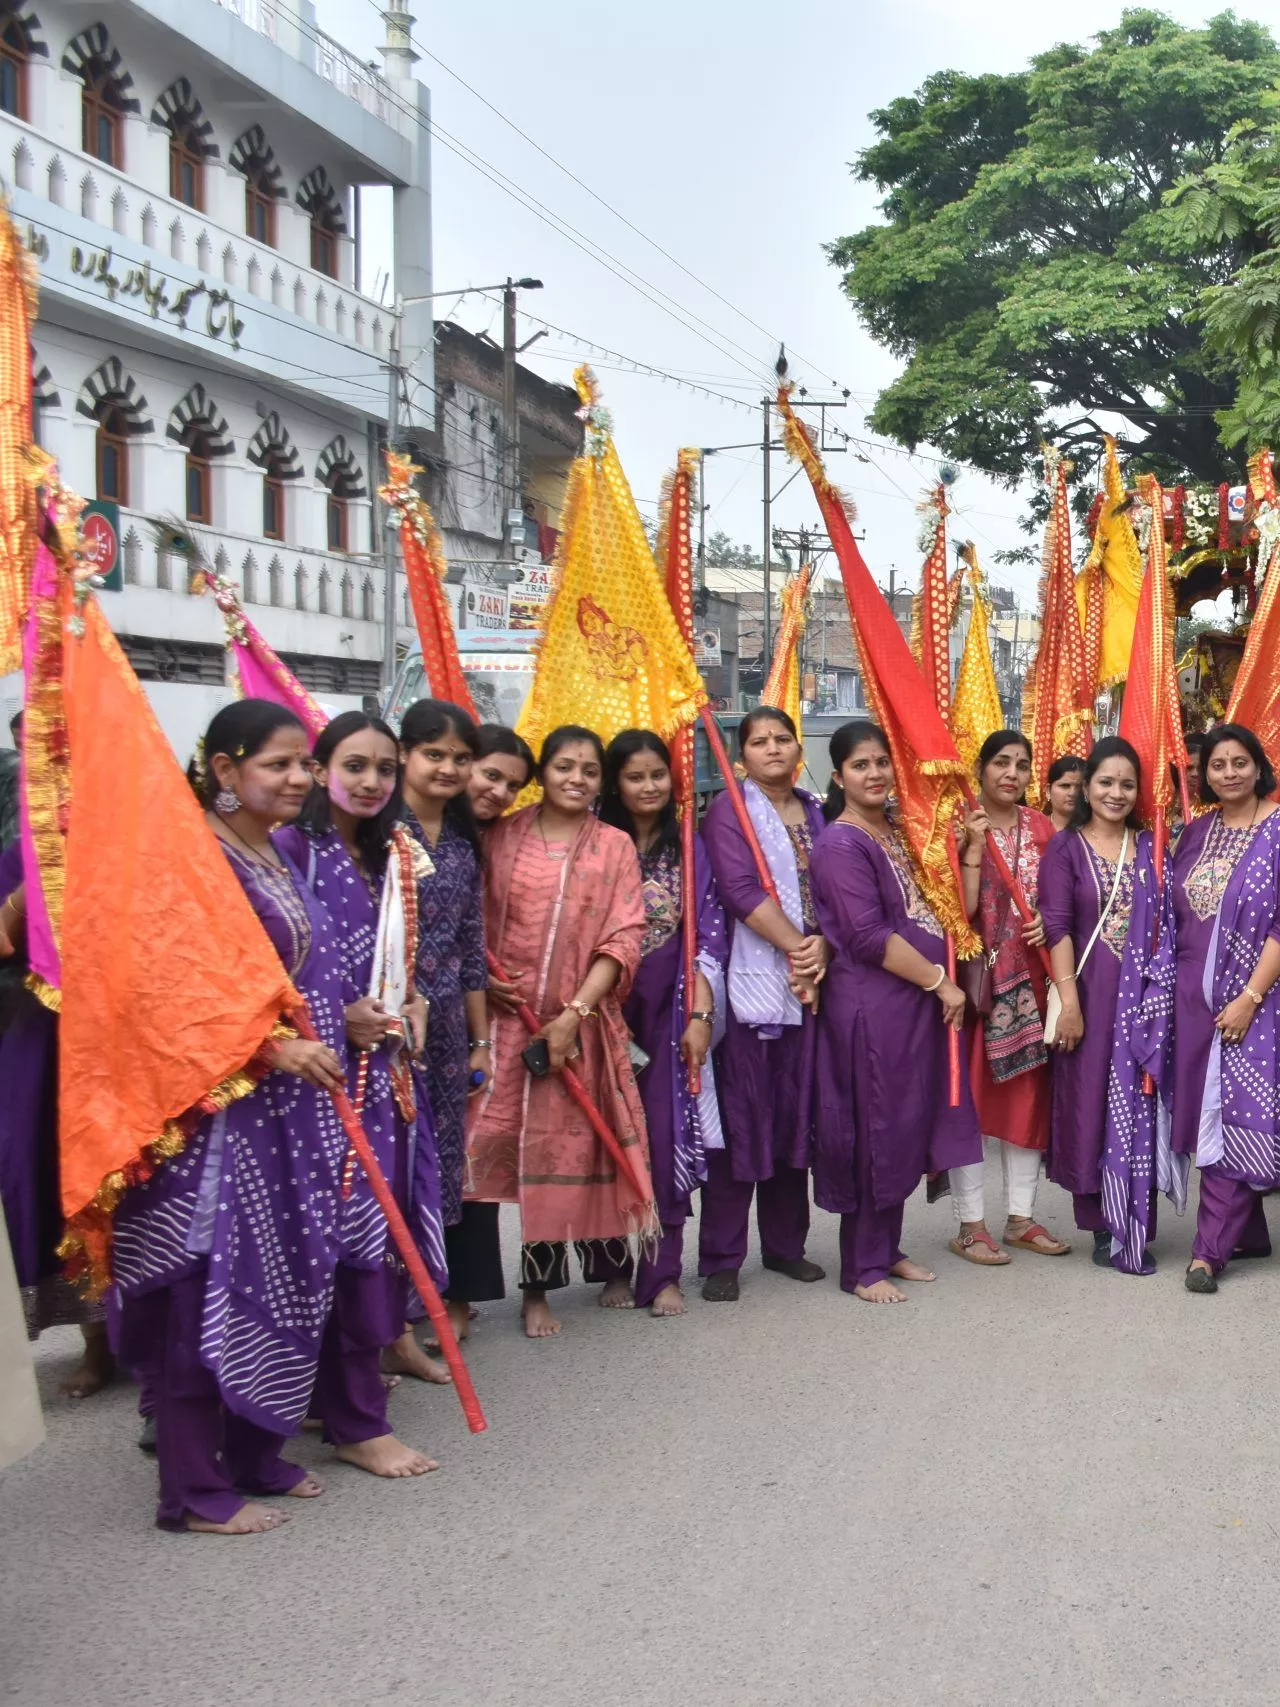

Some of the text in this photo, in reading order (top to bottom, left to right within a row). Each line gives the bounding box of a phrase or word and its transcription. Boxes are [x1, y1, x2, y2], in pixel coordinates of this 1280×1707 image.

[529, 571, 549, 584] ZA
[525, 584, 550, 593] TRAD
[479, 594, 504, 616] ZAKI
[476, 614, 506, 630] TRADERS
